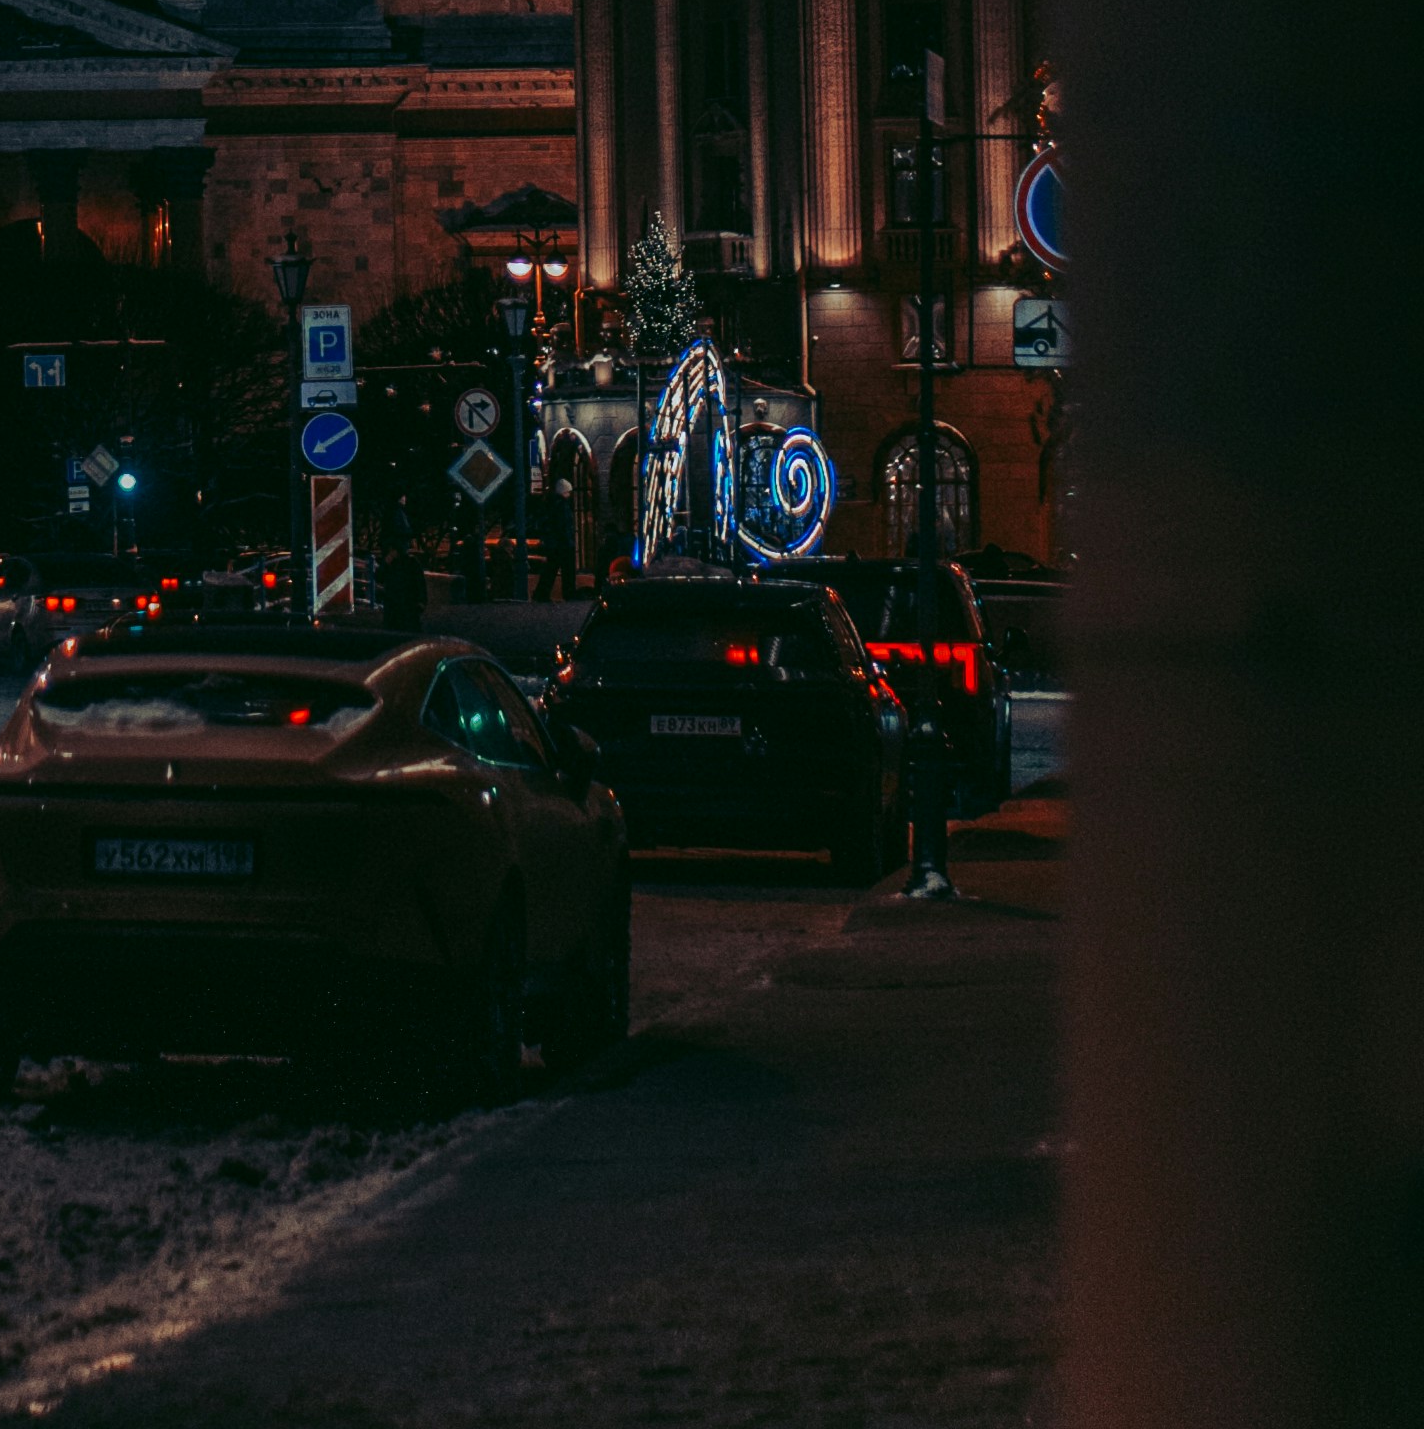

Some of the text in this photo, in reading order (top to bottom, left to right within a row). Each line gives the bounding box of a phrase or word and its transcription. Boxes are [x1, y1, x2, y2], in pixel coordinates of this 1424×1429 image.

[313, 310, 340, 320] ЗОНА
[319, 330, 338, 358] P
[656, 716, 717, 733] Е873КН
[104, 841, 205, 870] У562ХМ
